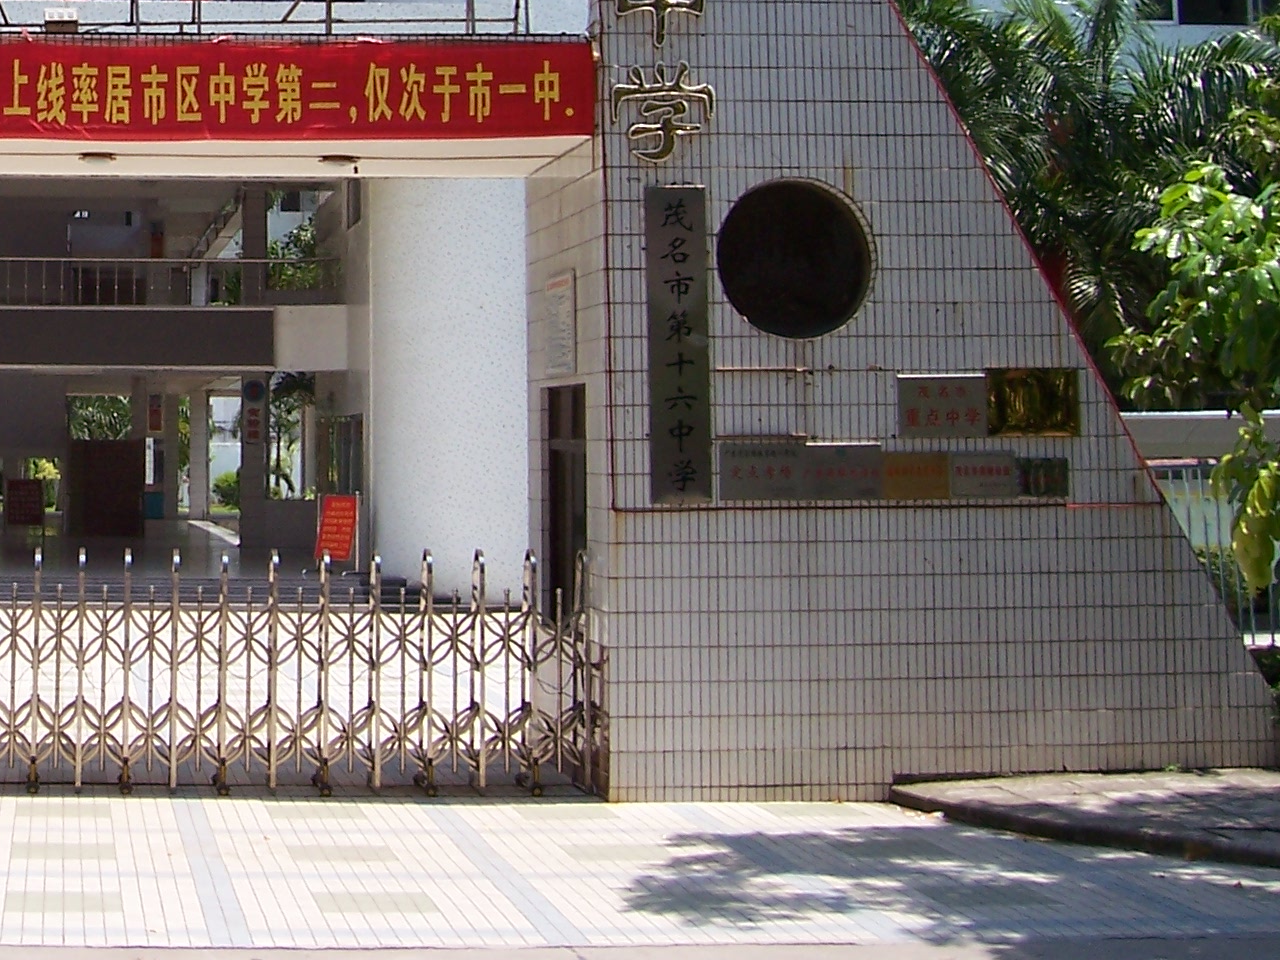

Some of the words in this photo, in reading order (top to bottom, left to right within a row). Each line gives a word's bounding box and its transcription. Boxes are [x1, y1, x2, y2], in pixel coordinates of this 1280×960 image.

[658, 196, 699, 493] 茂名市第十六中学
[904, 407, 982, 429] 重点中学
